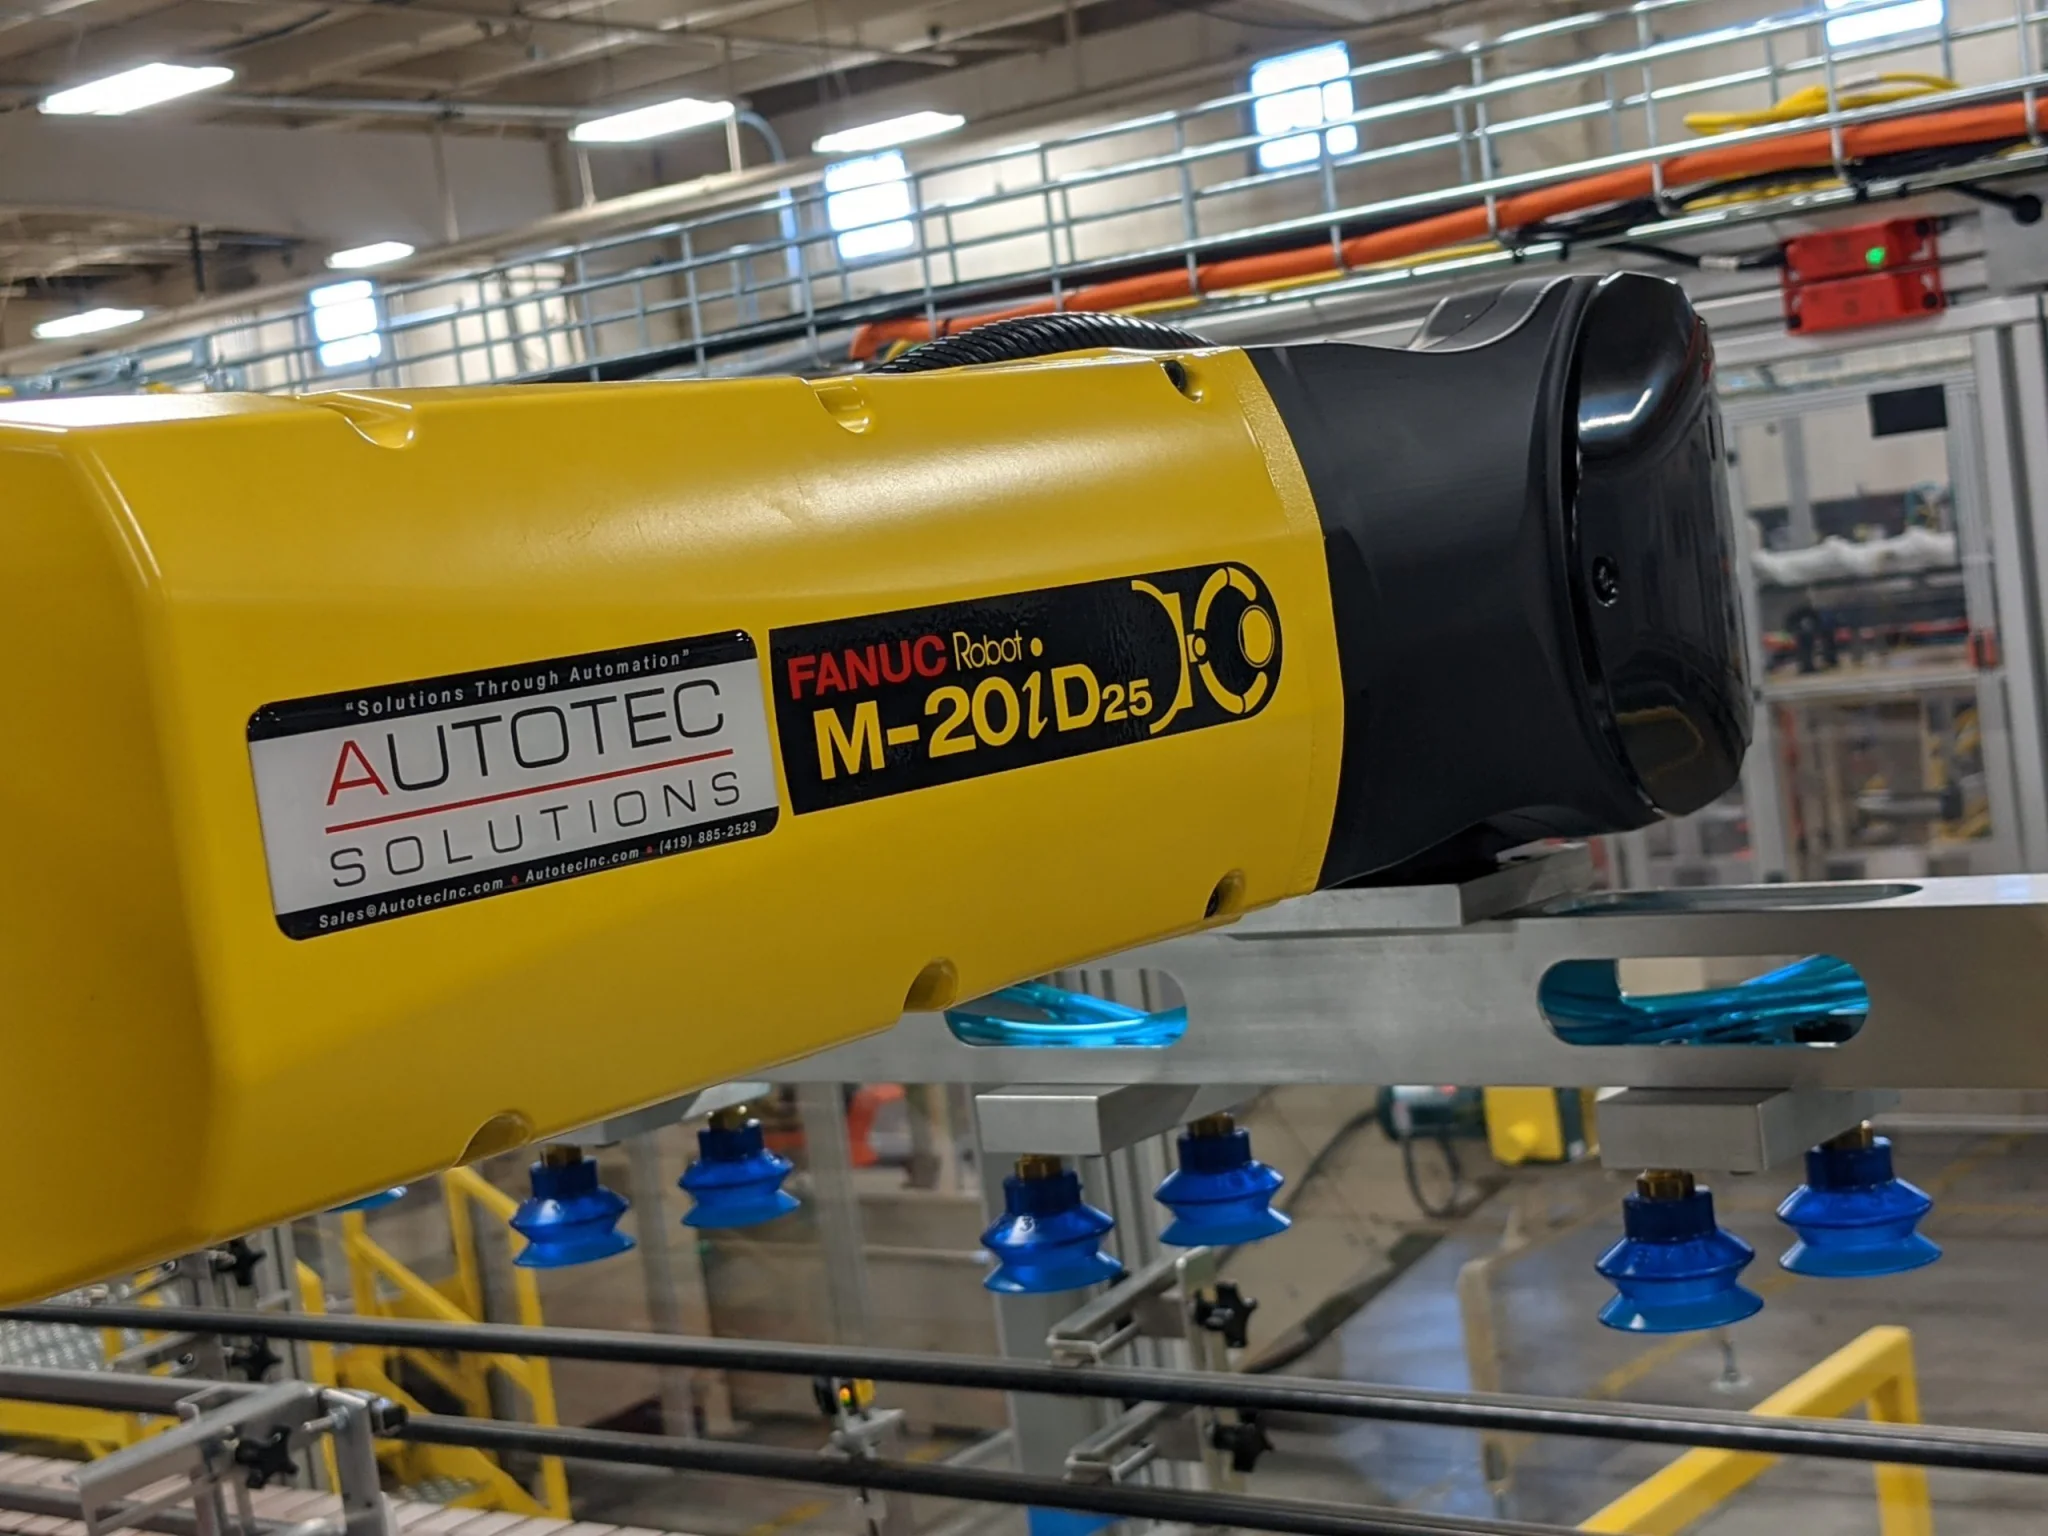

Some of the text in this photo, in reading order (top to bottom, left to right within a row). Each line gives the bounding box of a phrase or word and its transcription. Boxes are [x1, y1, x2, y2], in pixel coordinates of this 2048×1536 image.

[474, 670, 559, 698] Through
[787, 630, 1023, 700] FANUC Robot
[326, 678, 724, 806] AUTOTEC
[319, 820, 757, 929] Sales@AutotecInc.com AutotecInc.com (419) 885-2529
[330, 771, 741, 888] SOLUTIONS
